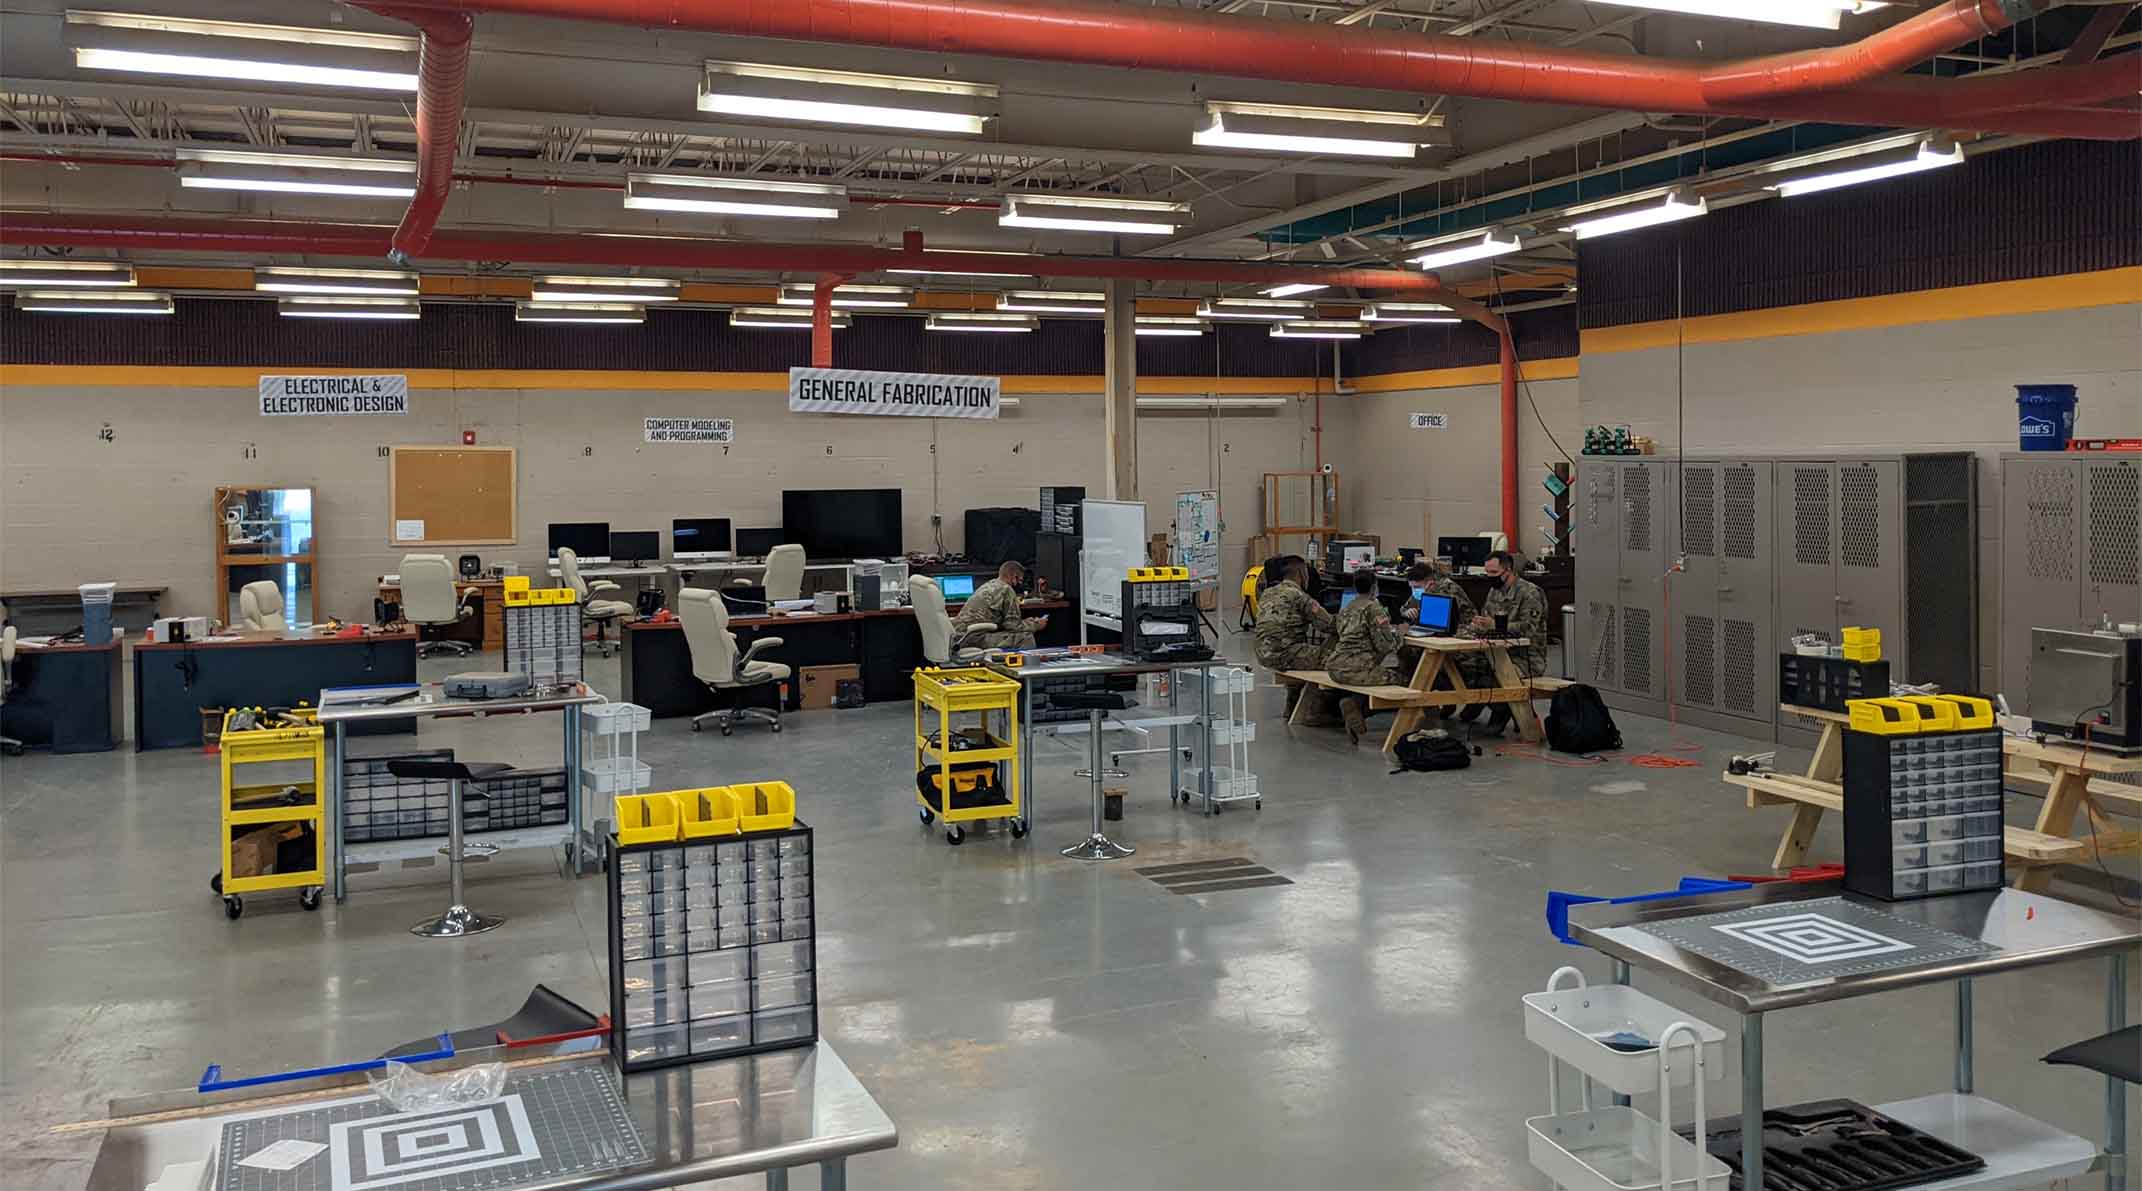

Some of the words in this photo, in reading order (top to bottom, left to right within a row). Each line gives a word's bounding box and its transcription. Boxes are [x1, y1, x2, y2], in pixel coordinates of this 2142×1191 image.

[284, 378, 367, 395] ELECTRICAL
[372, 379, 382, 392] &
[799, 378, 876, 403] GENERAL
[880, 382, 991, 408] FABRICATION
[263, 396, 349, 413] ELECTRONIC
[353, 395, 404, 412] DESIGN
[646, 419, 690, 431] COMPUTER
[691, 420, 731, 431] MODELING
[1418, 415, 1442, 426] OFFICE
[99, 429, 113, 441] 12
[2020, 425, 2050, 434] OWE'S
[650, 430, 668, 441] AND
[669, 431, 728, 442] PROGRAMMING
[245, 447, 257, 460] 11
[377, 446, 390, 457] 10
[722, 445, 729, 456] 7
